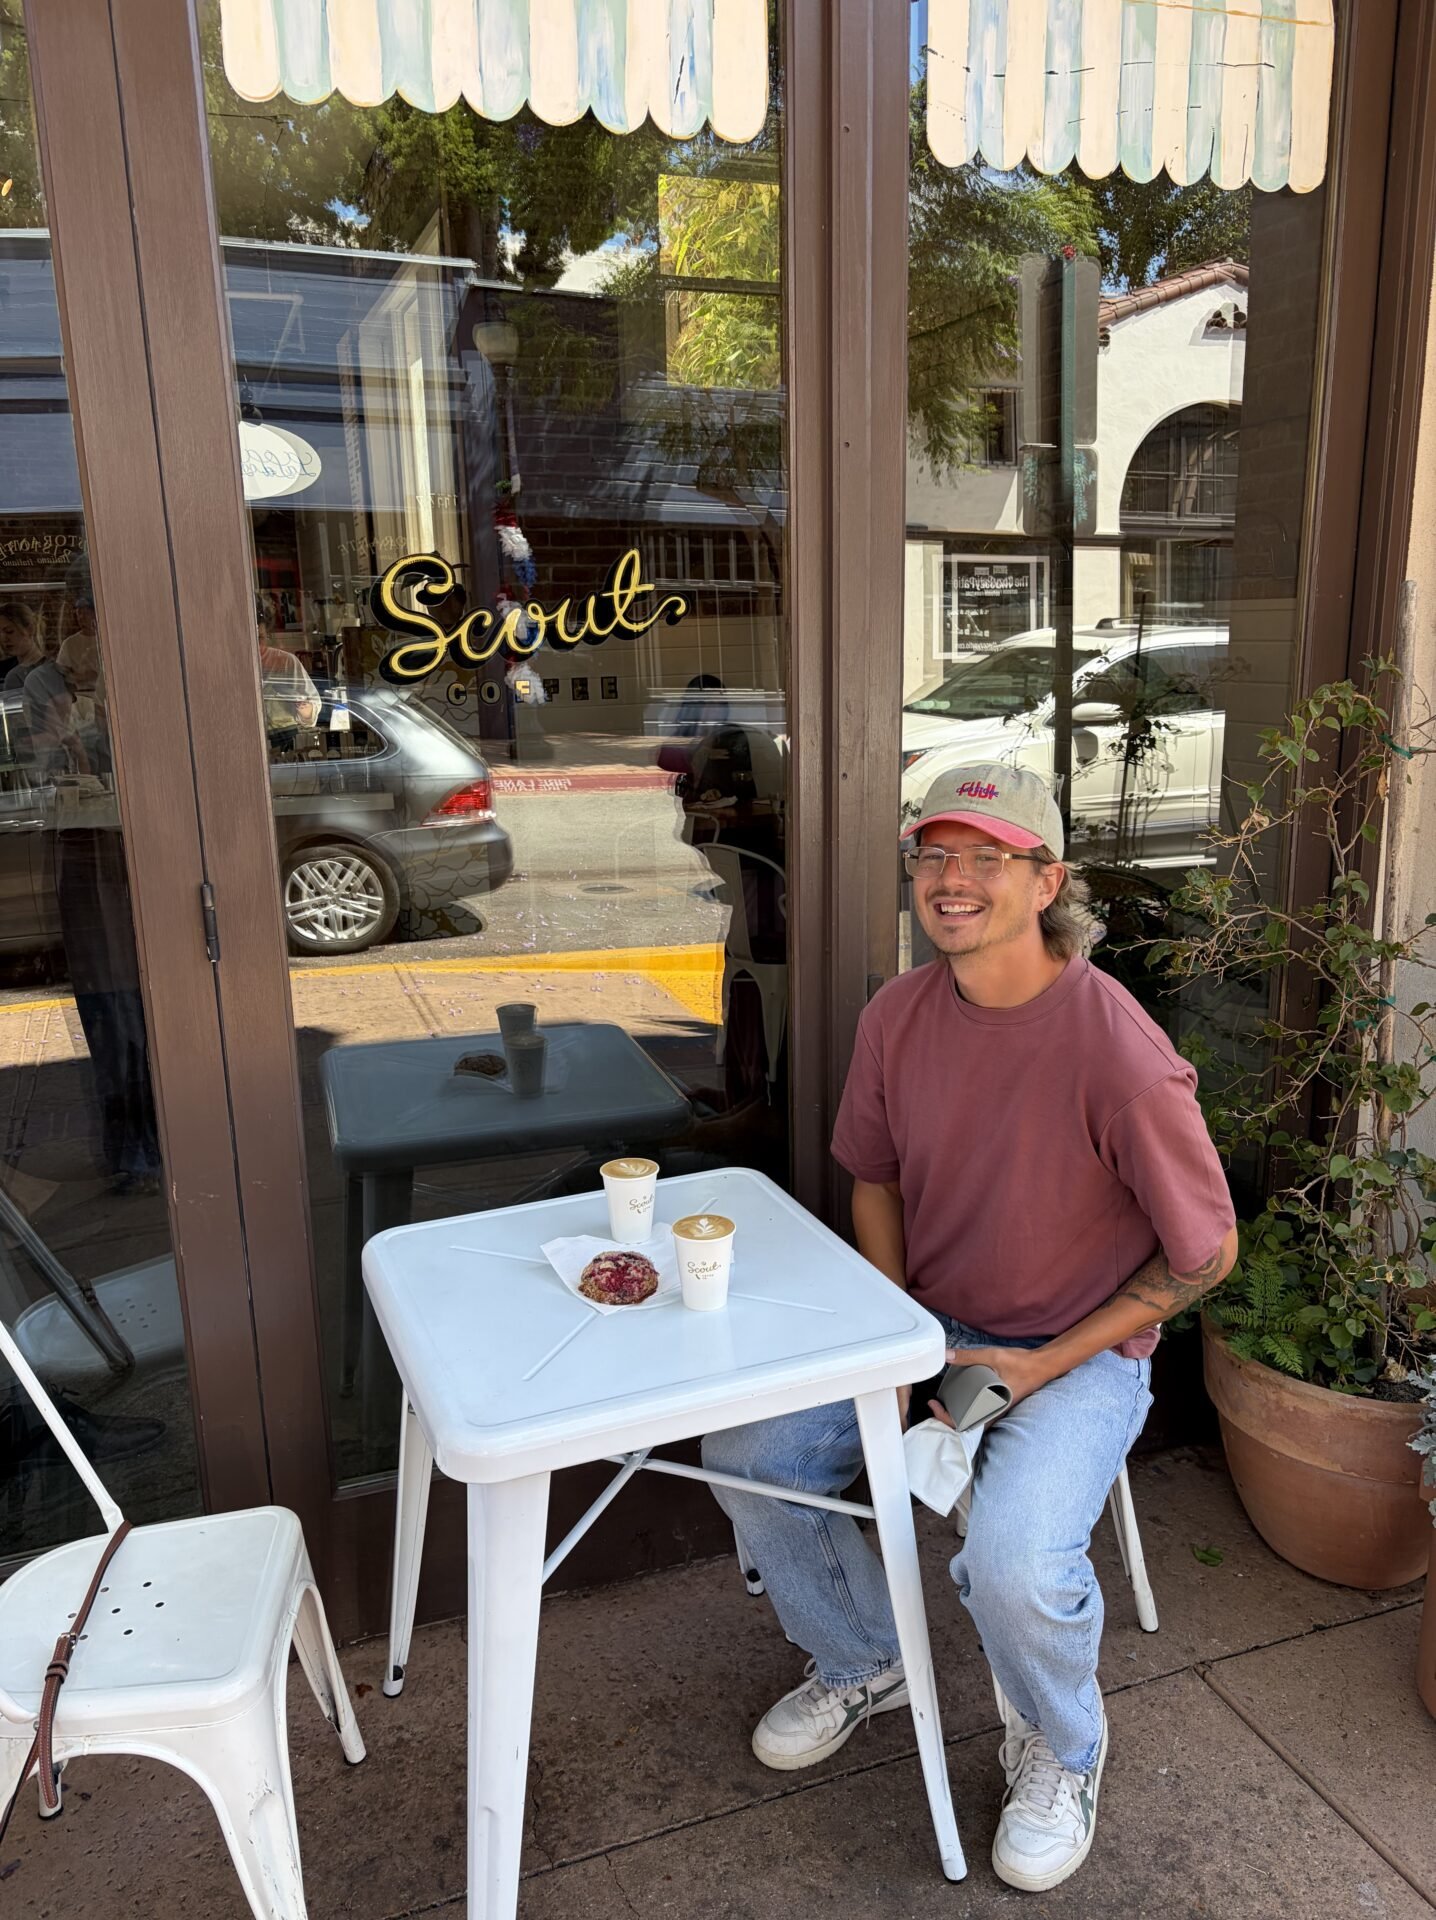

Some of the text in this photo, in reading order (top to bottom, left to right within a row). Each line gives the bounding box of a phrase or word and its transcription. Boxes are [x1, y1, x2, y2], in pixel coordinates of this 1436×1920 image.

[373, 549, 689, 682] Scout
[447, 676, 619, 705] COFFEE
[687, 1261, 722, 1274] Scout
